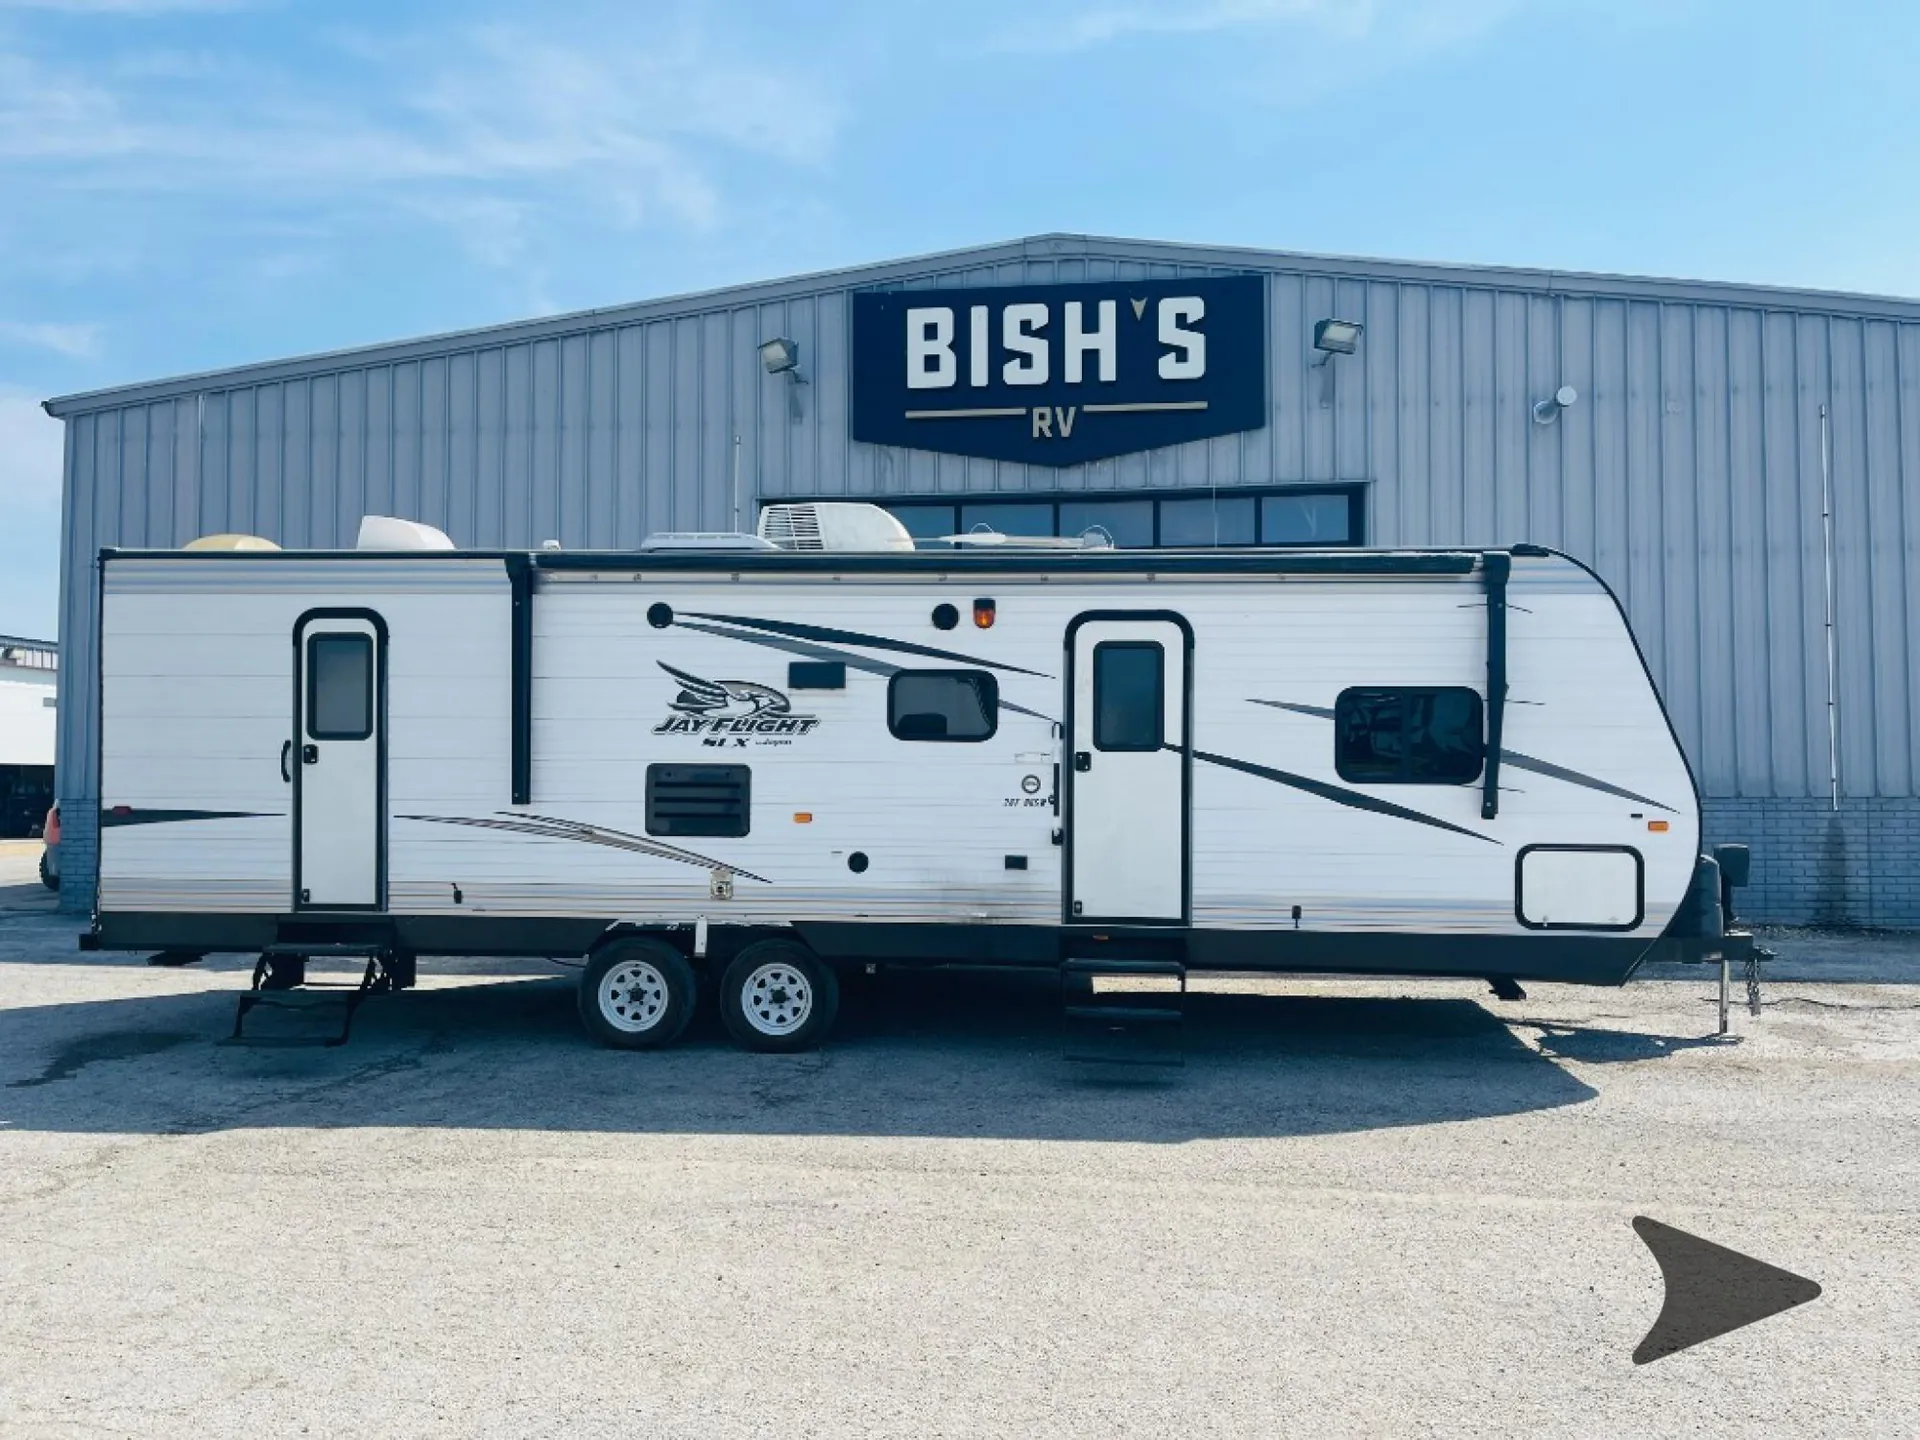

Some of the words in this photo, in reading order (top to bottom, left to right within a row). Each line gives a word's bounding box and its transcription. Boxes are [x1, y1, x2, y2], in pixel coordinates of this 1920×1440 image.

[906, 295, 1206, 390] BISH'S
[1031, 406, 1077, 438] RV
[652, 715, 706, 735] JAY
[708, 716, 821, 735] FLIGHT
